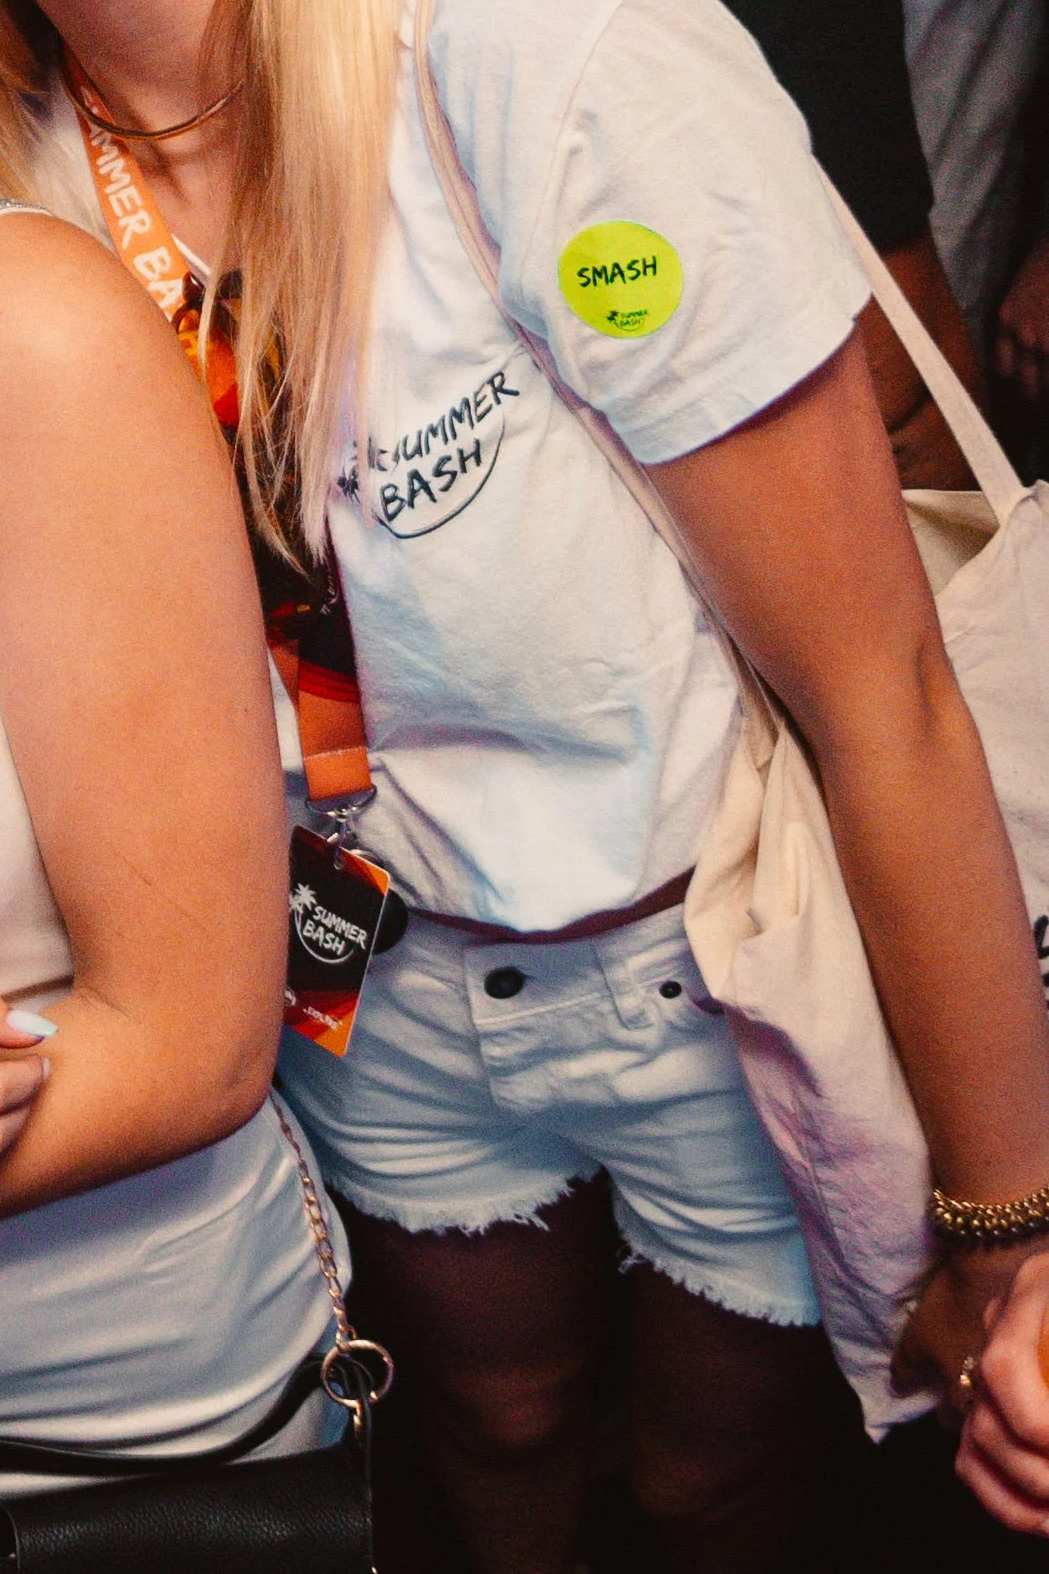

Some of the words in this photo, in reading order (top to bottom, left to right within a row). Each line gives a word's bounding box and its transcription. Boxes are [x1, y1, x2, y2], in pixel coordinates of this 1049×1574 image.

[577, 255, 657, 288] SMASH
[380, 437, 483, 522] BASH
[302, 918, 345, 956] BASH
[313, 906, 367, 950] SUMMER
